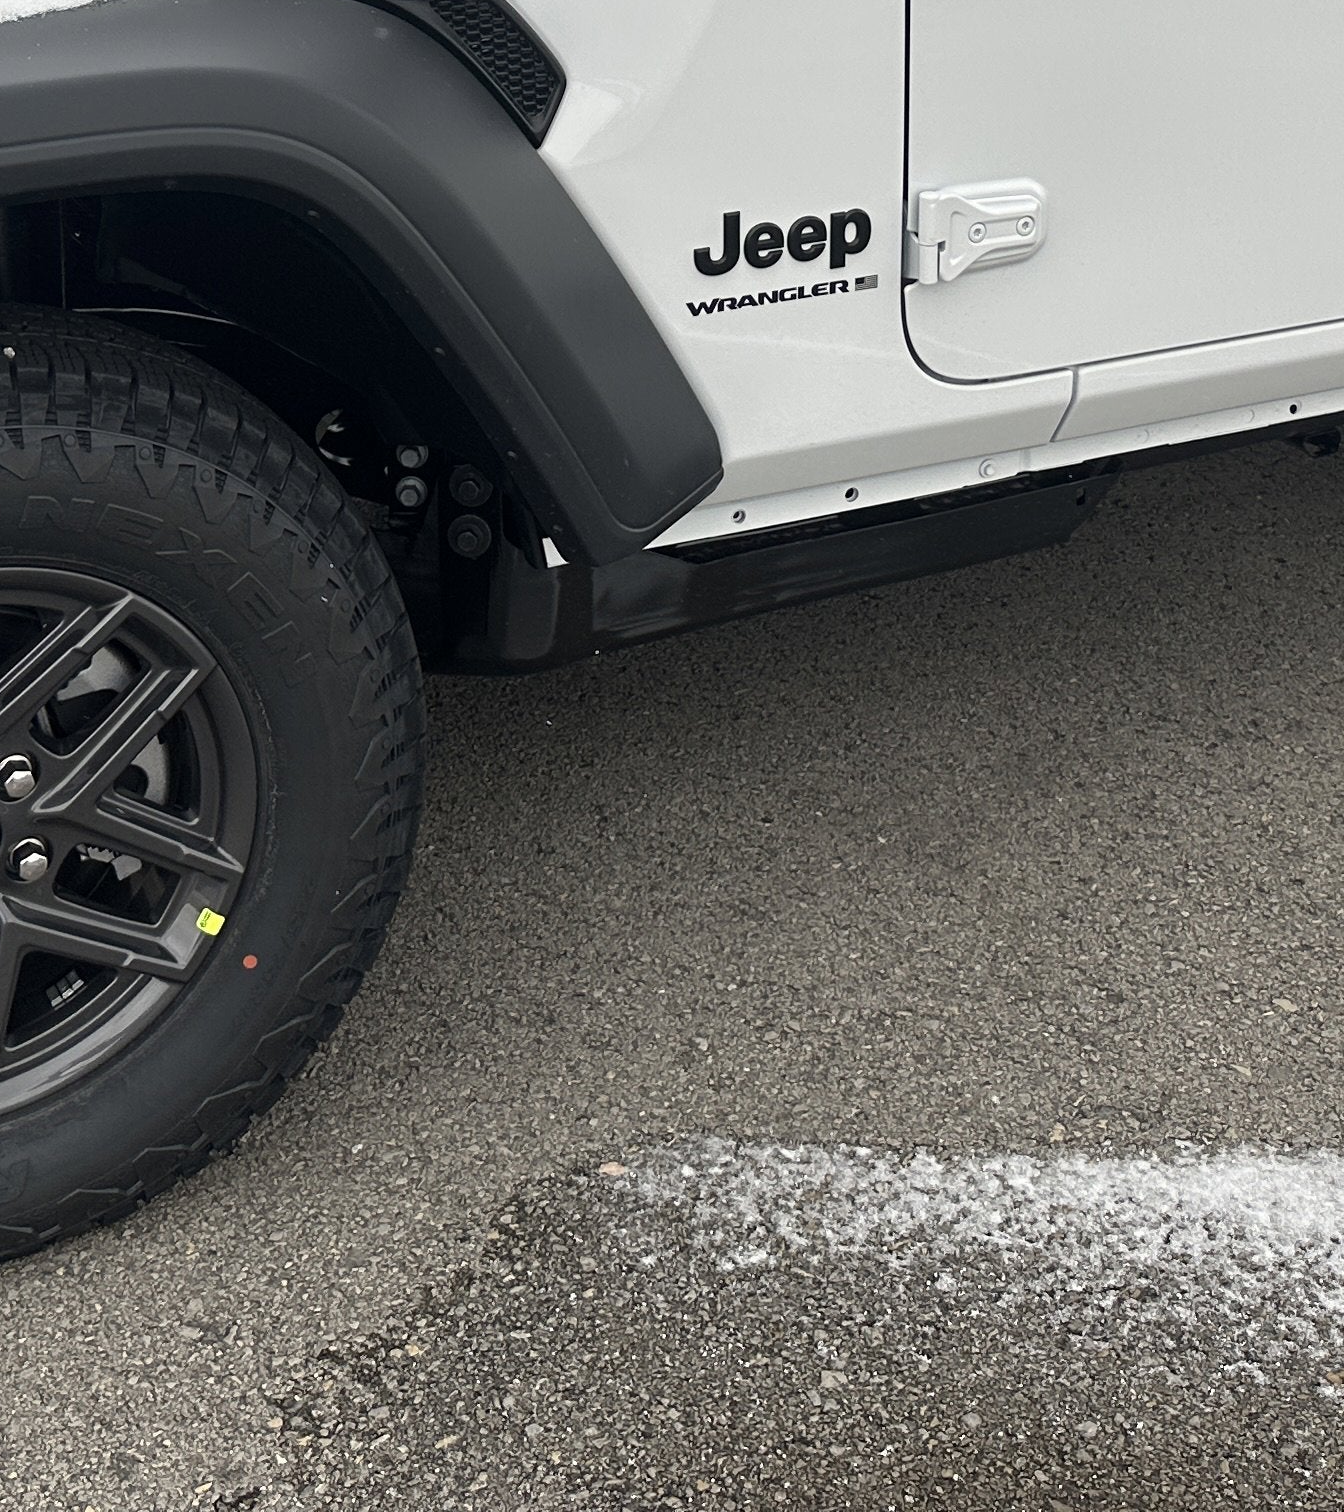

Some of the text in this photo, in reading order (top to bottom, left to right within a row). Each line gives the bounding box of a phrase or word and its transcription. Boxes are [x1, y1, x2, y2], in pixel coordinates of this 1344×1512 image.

[693, 208, 872, 276] Jeep
[686, 279, 849, 317] WRANGLER
[17, 494, 313, 687] NEXEN
